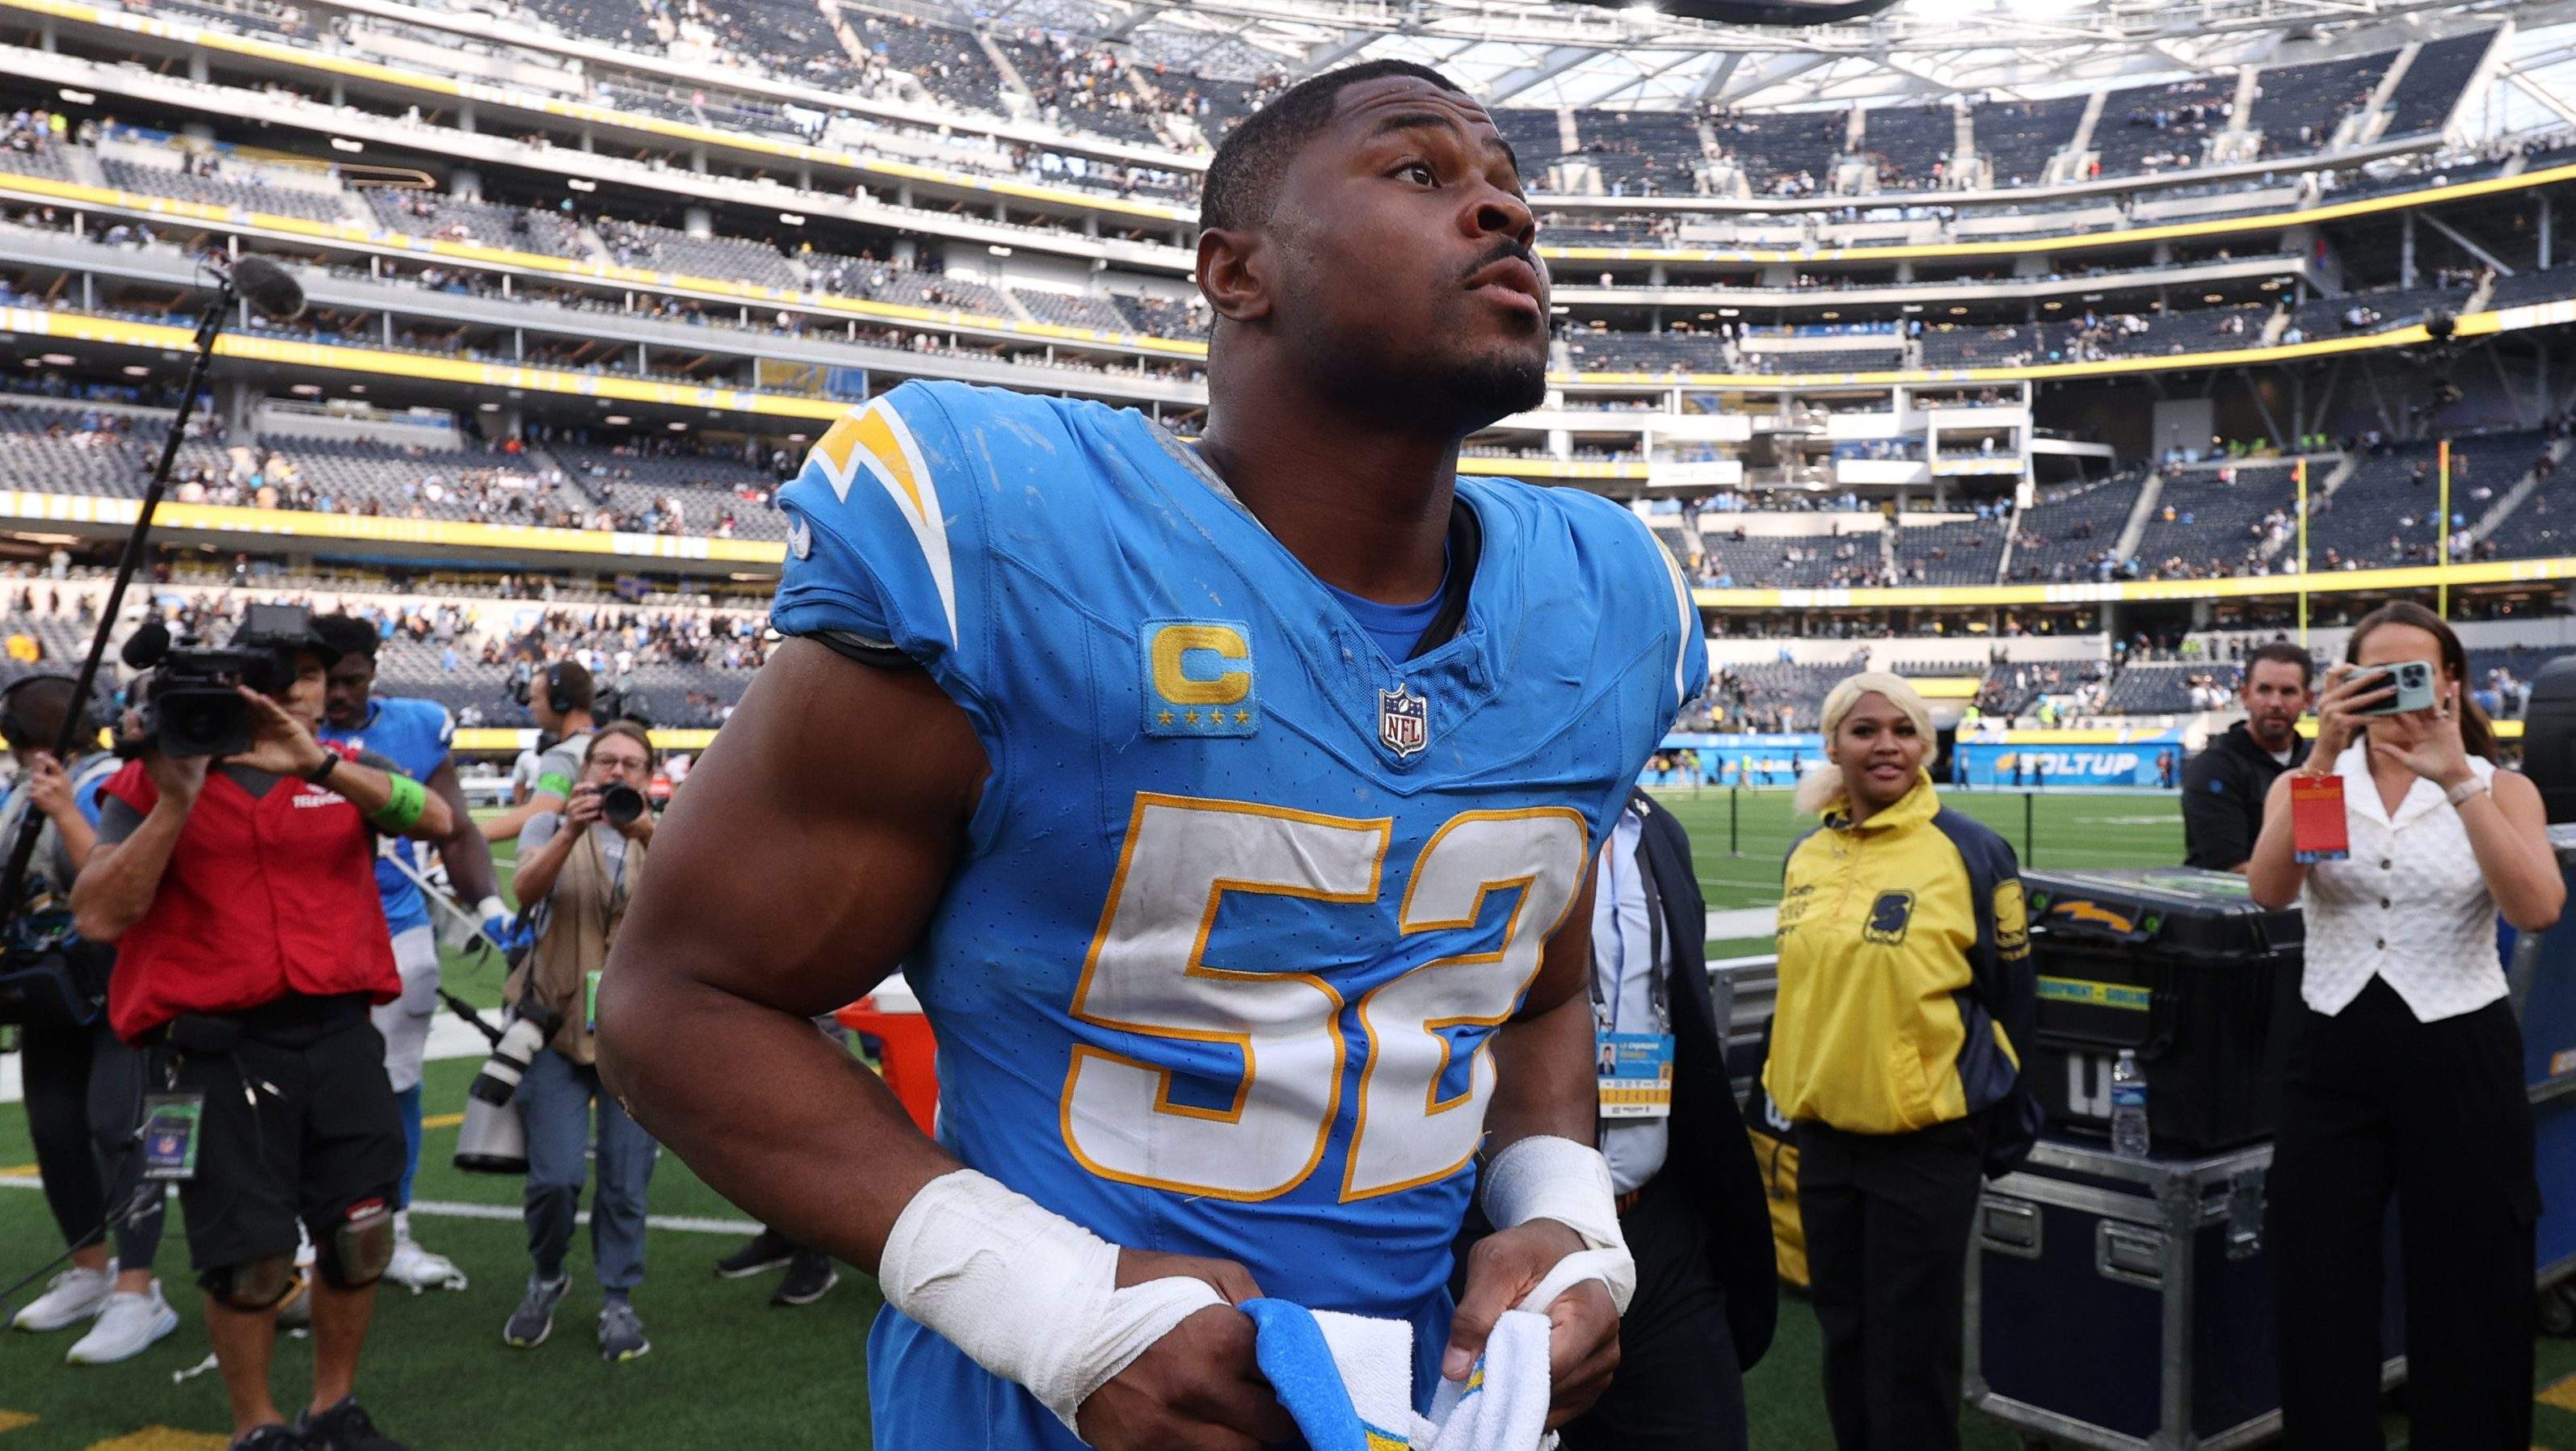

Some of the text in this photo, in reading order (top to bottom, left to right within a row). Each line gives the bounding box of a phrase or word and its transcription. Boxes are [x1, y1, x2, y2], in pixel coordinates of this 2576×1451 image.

[1152, 625, 1252, 705] C
[1386, 715, 1421, 745] NFL
[1059, 791, 1588, 1204] 52
